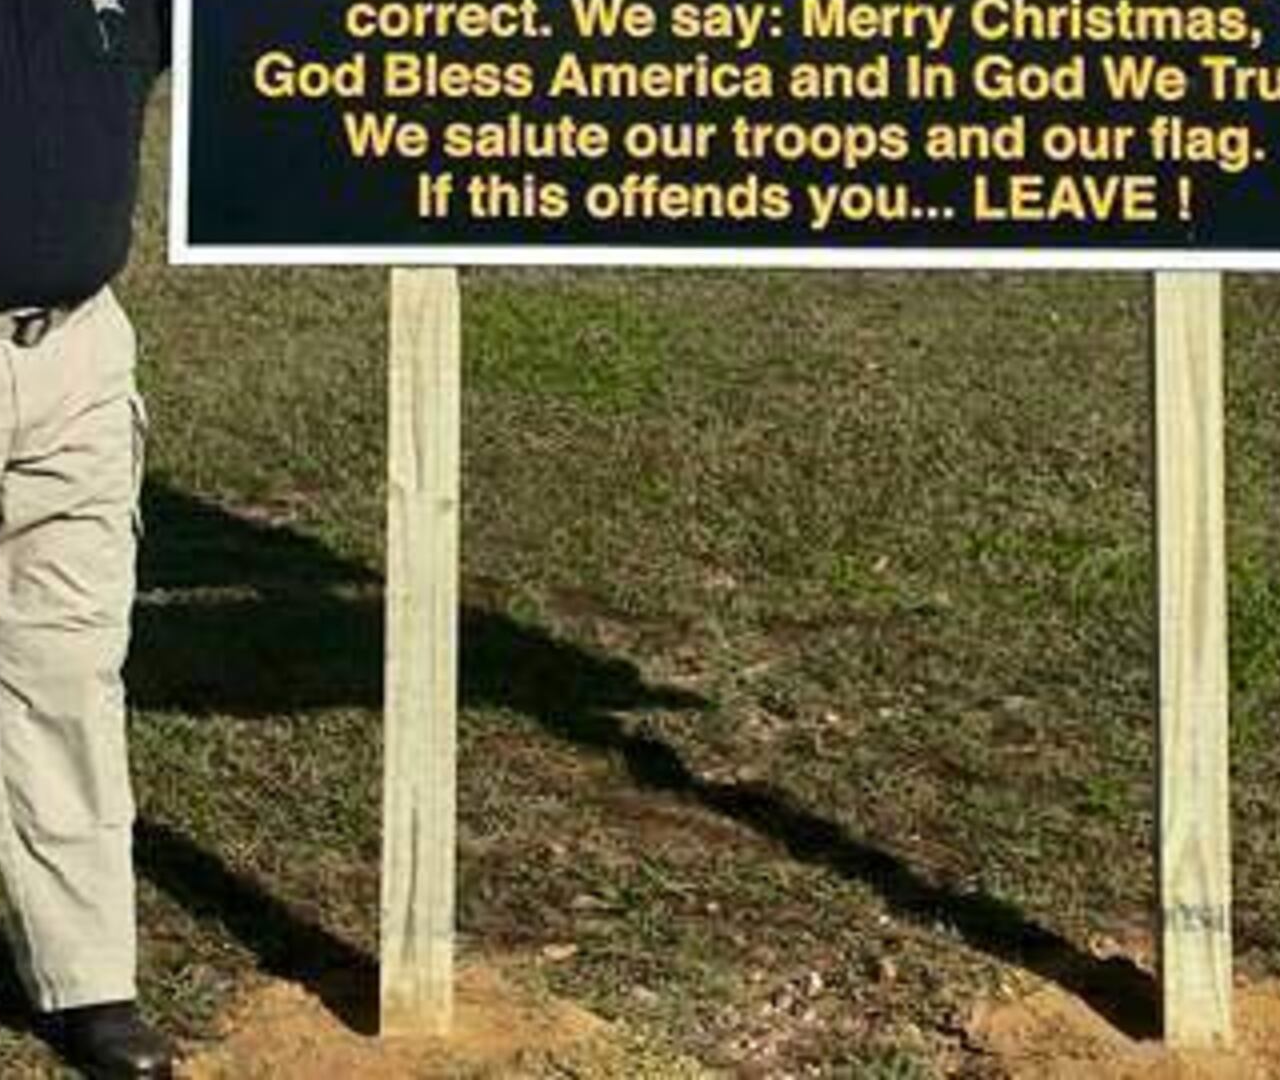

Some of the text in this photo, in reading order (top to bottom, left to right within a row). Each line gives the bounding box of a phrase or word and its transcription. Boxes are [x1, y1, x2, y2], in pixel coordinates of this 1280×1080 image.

[672, 4, 782, 48] say:
[254, 52, 364, 97] God
[386, 53, 532, 97] Bless
[549, 54, 773, 98] America
[790, 56, 888, 99] and
[908, 56, 954, 99] In
[974, 55, 1084, 100] God
[1103, 56, 1186, 100] We
[344, 113, 1266, 172] We salute our troops and our flag.
[419, 173, 1192, 229] If this offends you... LEAVE !
